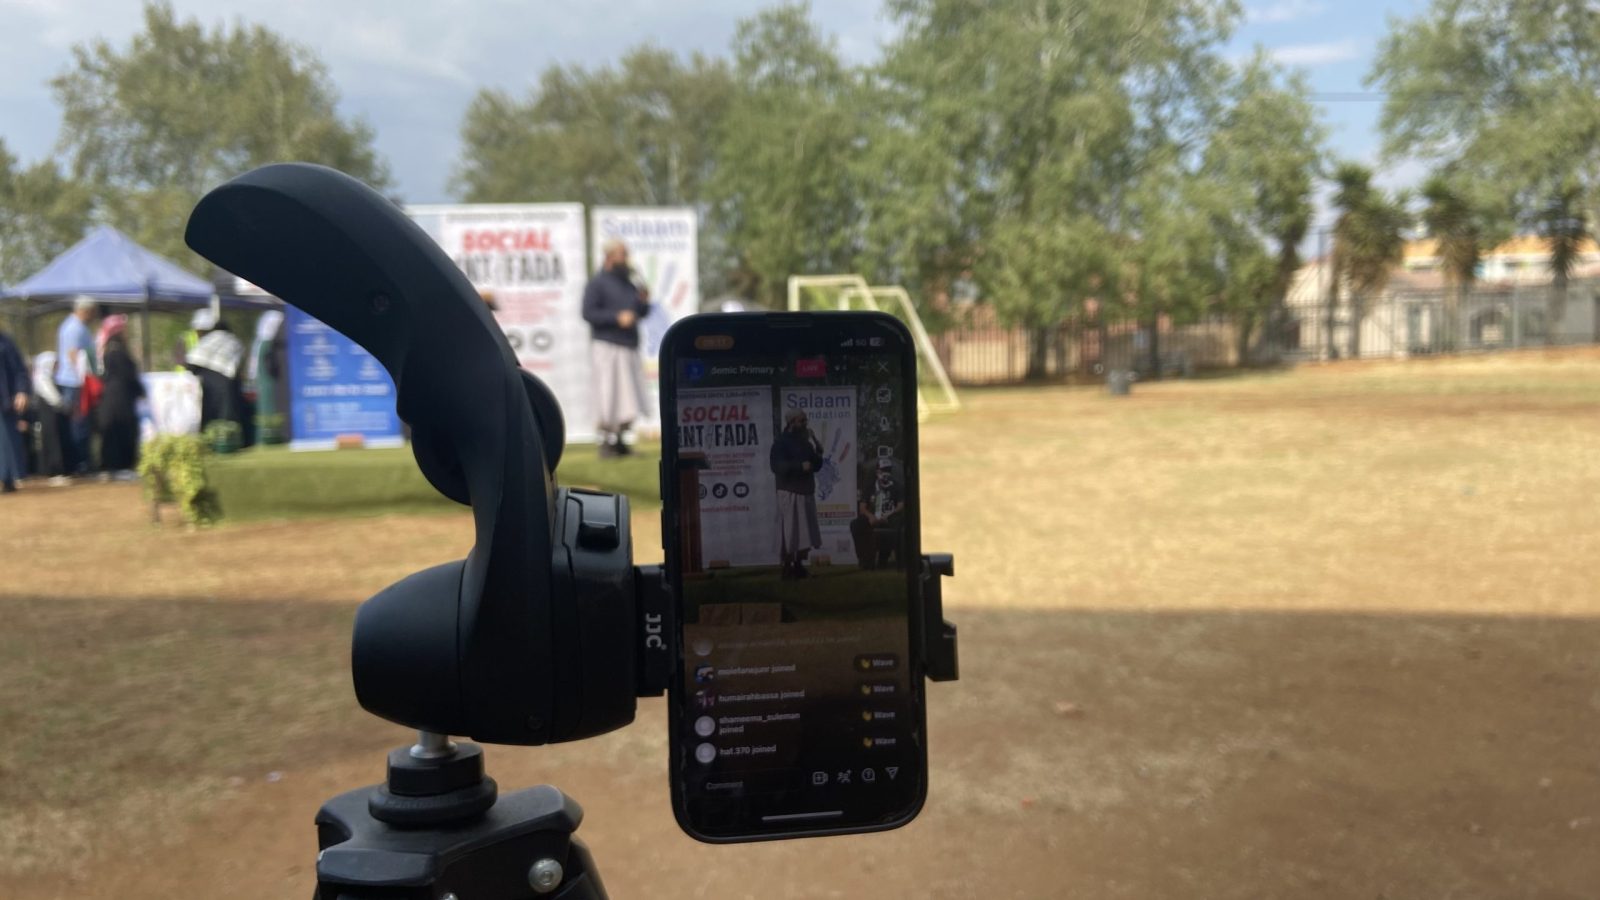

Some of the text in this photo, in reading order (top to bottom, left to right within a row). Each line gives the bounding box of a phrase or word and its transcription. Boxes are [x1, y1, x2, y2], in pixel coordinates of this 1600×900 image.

[462, 229, 552, 251] SOCIAL
[740, 365, 774, 375] Primary
[787, 393, 850, 408] Salaam
[682, 405, 750, 423] SOCIAL
[808, 411, 850, 419] ndation
[645, 613, 662, 649] JJC
[872, 659, 894, 667] Wave
[770, 664, 795, 673] joined
[873, 685, 895, 693] Wave
[781, 690, 805, 700] joined
[874, 711, 896, 719] Wave
[719, 725, 744, 736] joined
[875, 737, 897, 745] Wave
[752, 745, 776, 755] joined
[706, 780, 743, 790] Comment
